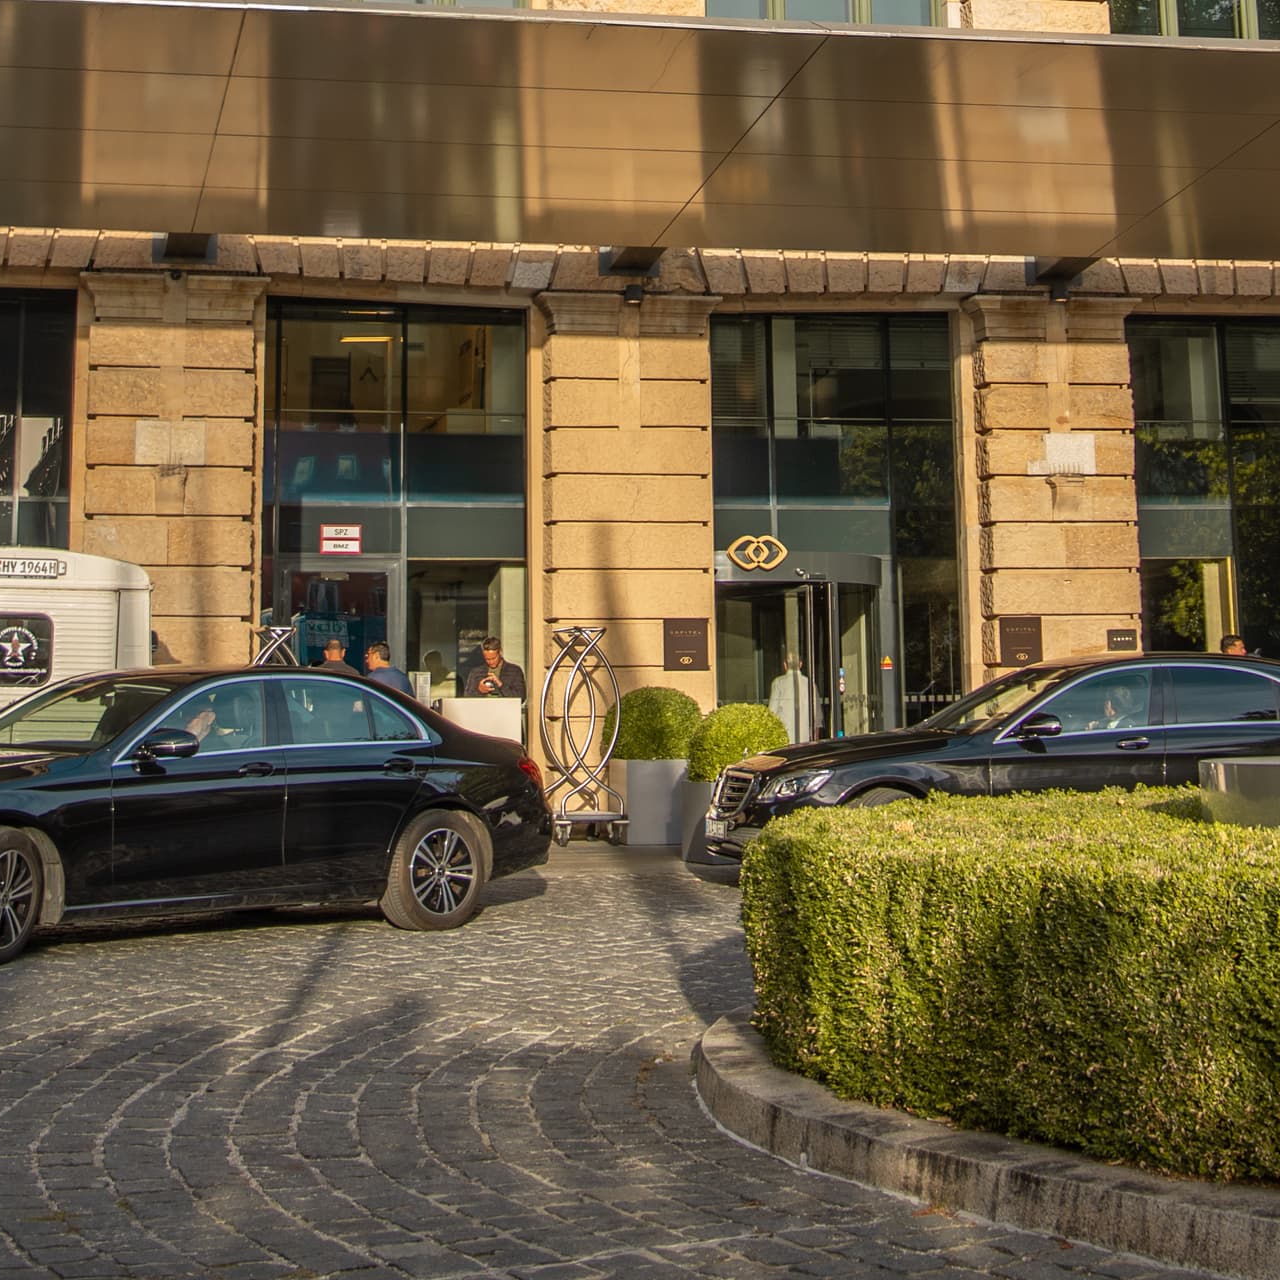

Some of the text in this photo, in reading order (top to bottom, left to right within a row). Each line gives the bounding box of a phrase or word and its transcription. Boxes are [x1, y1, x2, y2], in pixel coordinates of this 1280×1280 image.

[334, 528, 349, 536] SPZ
[2, 560, 17, 573] HY
[20, 561, 57, 574] 1964H
